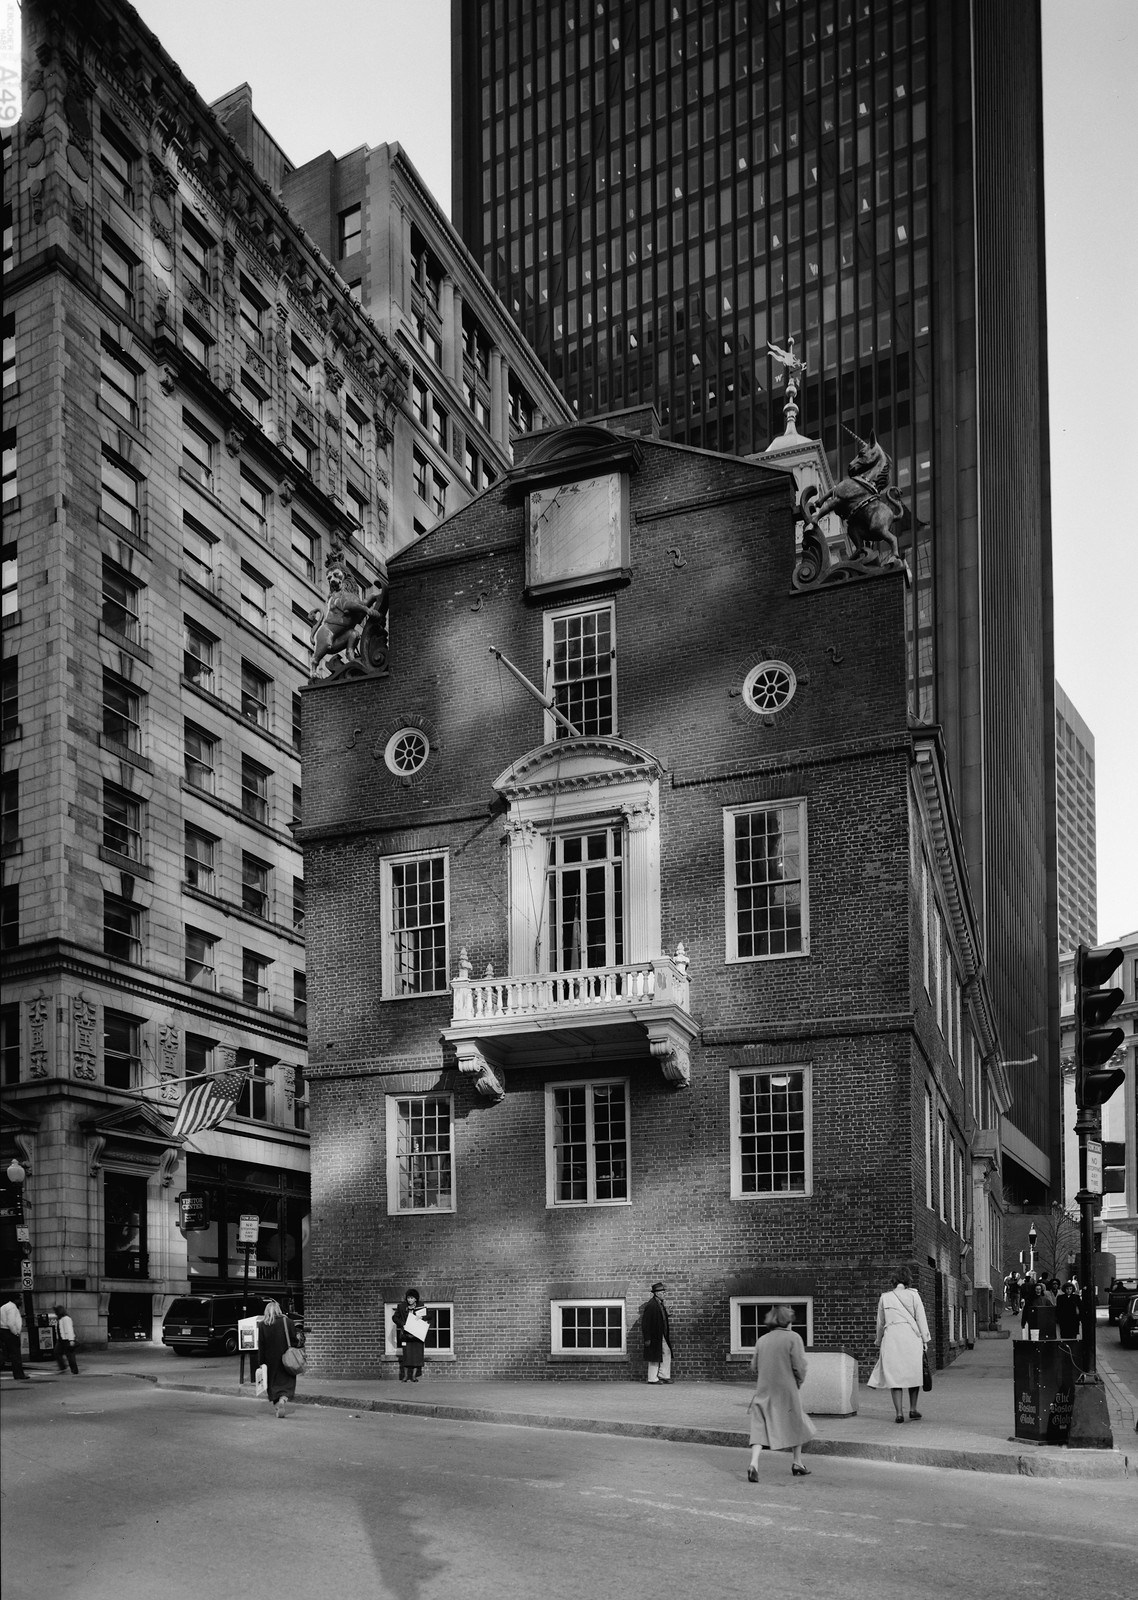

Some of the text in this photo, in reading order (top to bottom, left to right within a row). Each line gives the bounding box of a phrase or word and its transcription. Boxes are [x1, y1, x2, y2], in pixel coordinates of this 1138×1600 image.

[1091, 1157, 1097, 1165] NO
[1022, 1392, 1032, 1403] The
[1018, 1402, 1036, 1413] Boston
[1020, 1413, 1035, 1425] Globe
